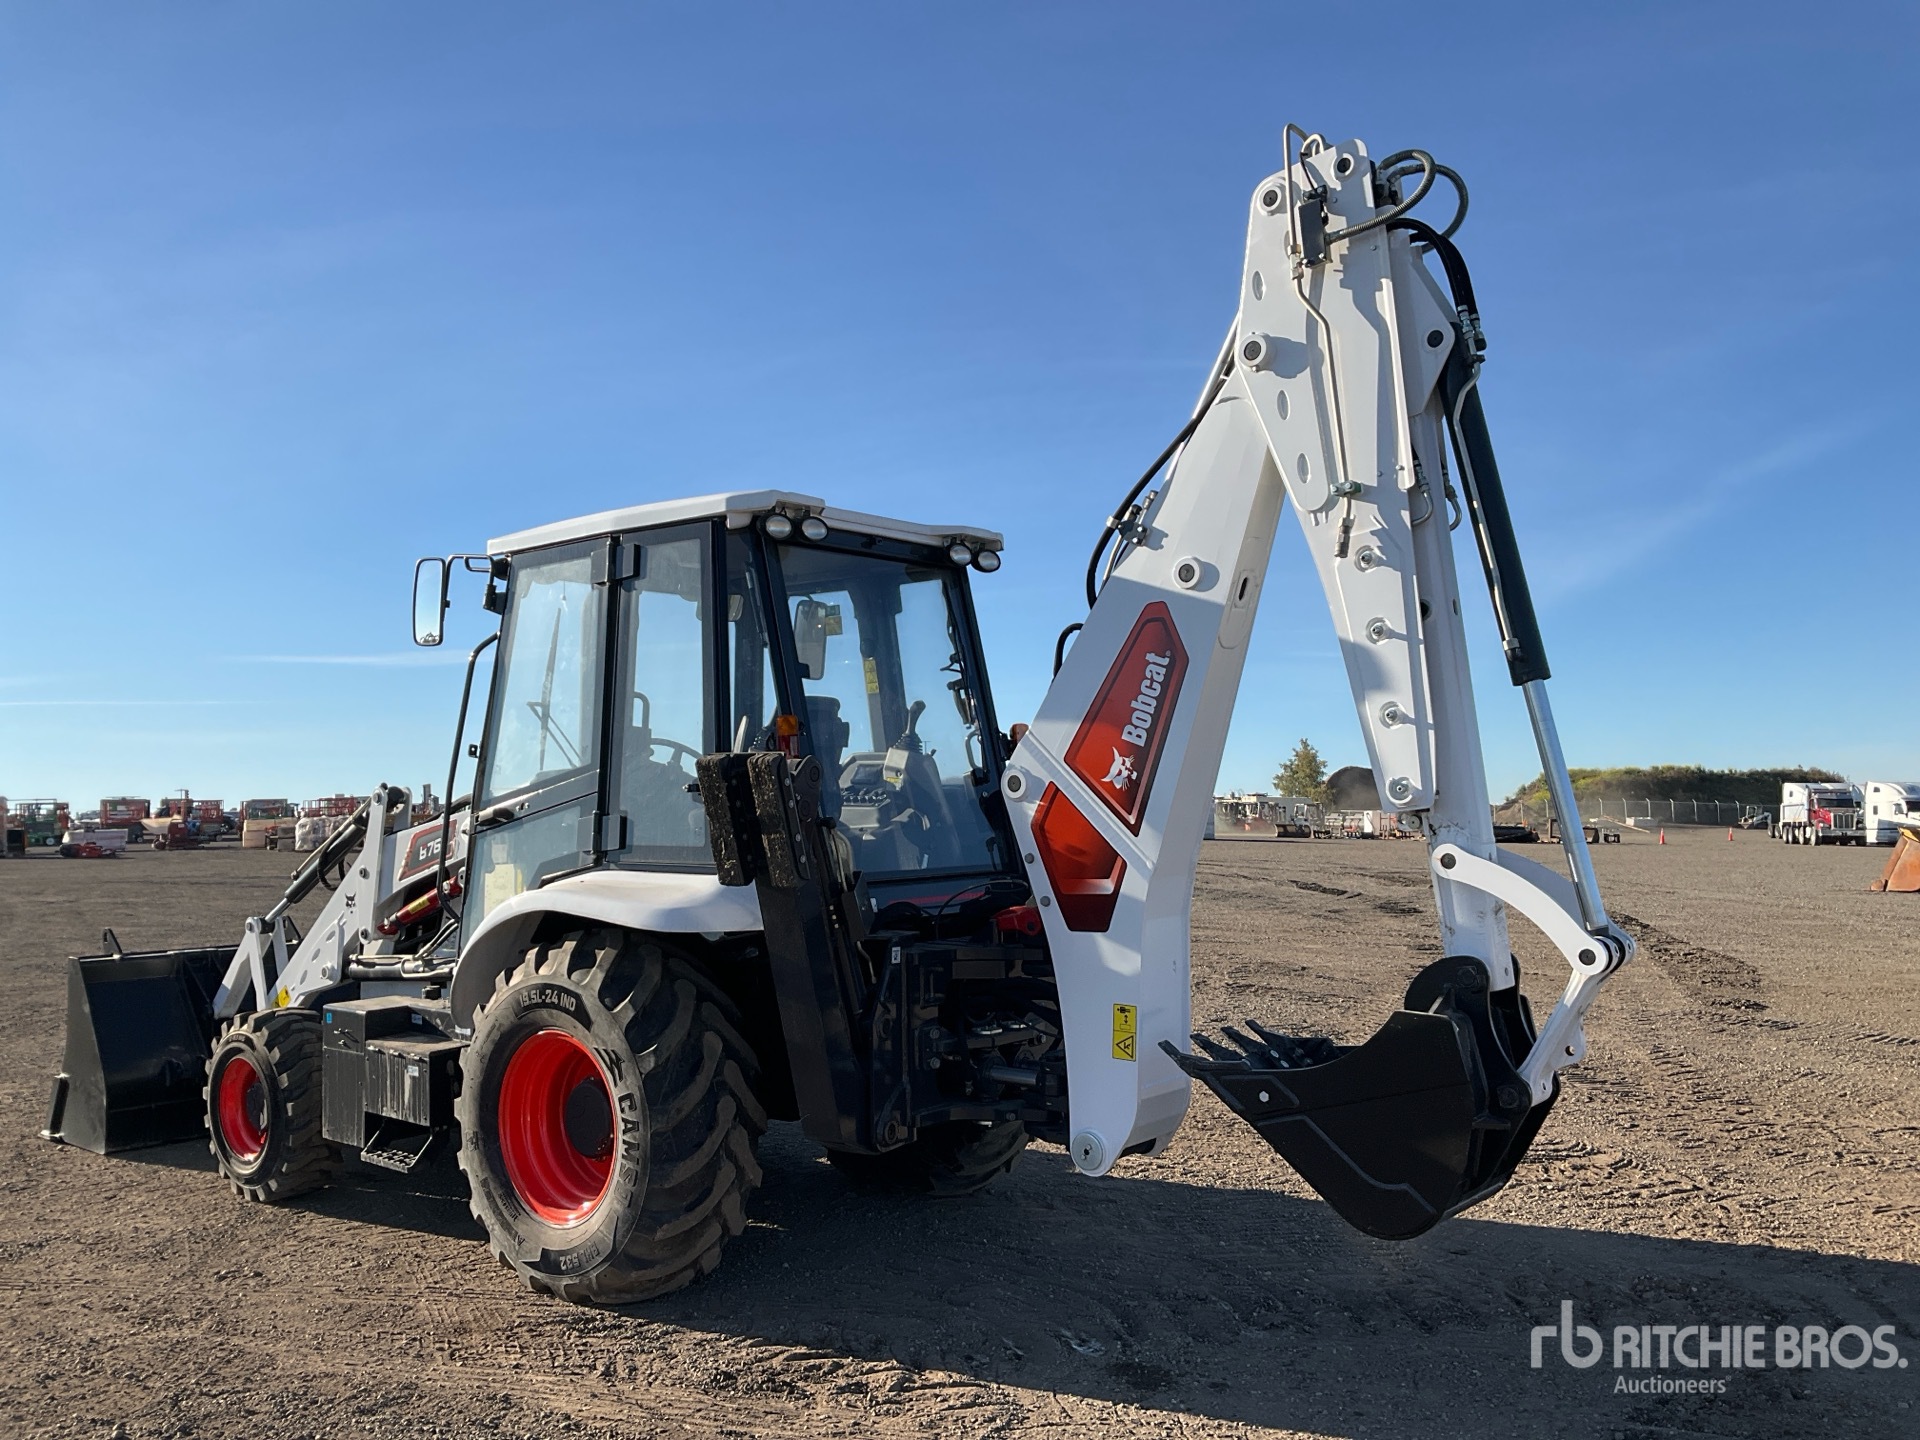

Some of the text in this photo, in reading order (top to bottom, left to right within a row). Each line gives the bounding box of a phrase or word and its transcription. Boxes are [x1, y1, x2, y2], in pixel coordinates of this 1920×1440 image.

[1121, 651, 1170, 747] Bobcat
[519, 989, 576, 1011] 19.5L-24 IND
[559, 1252, 581, 1270] 532
